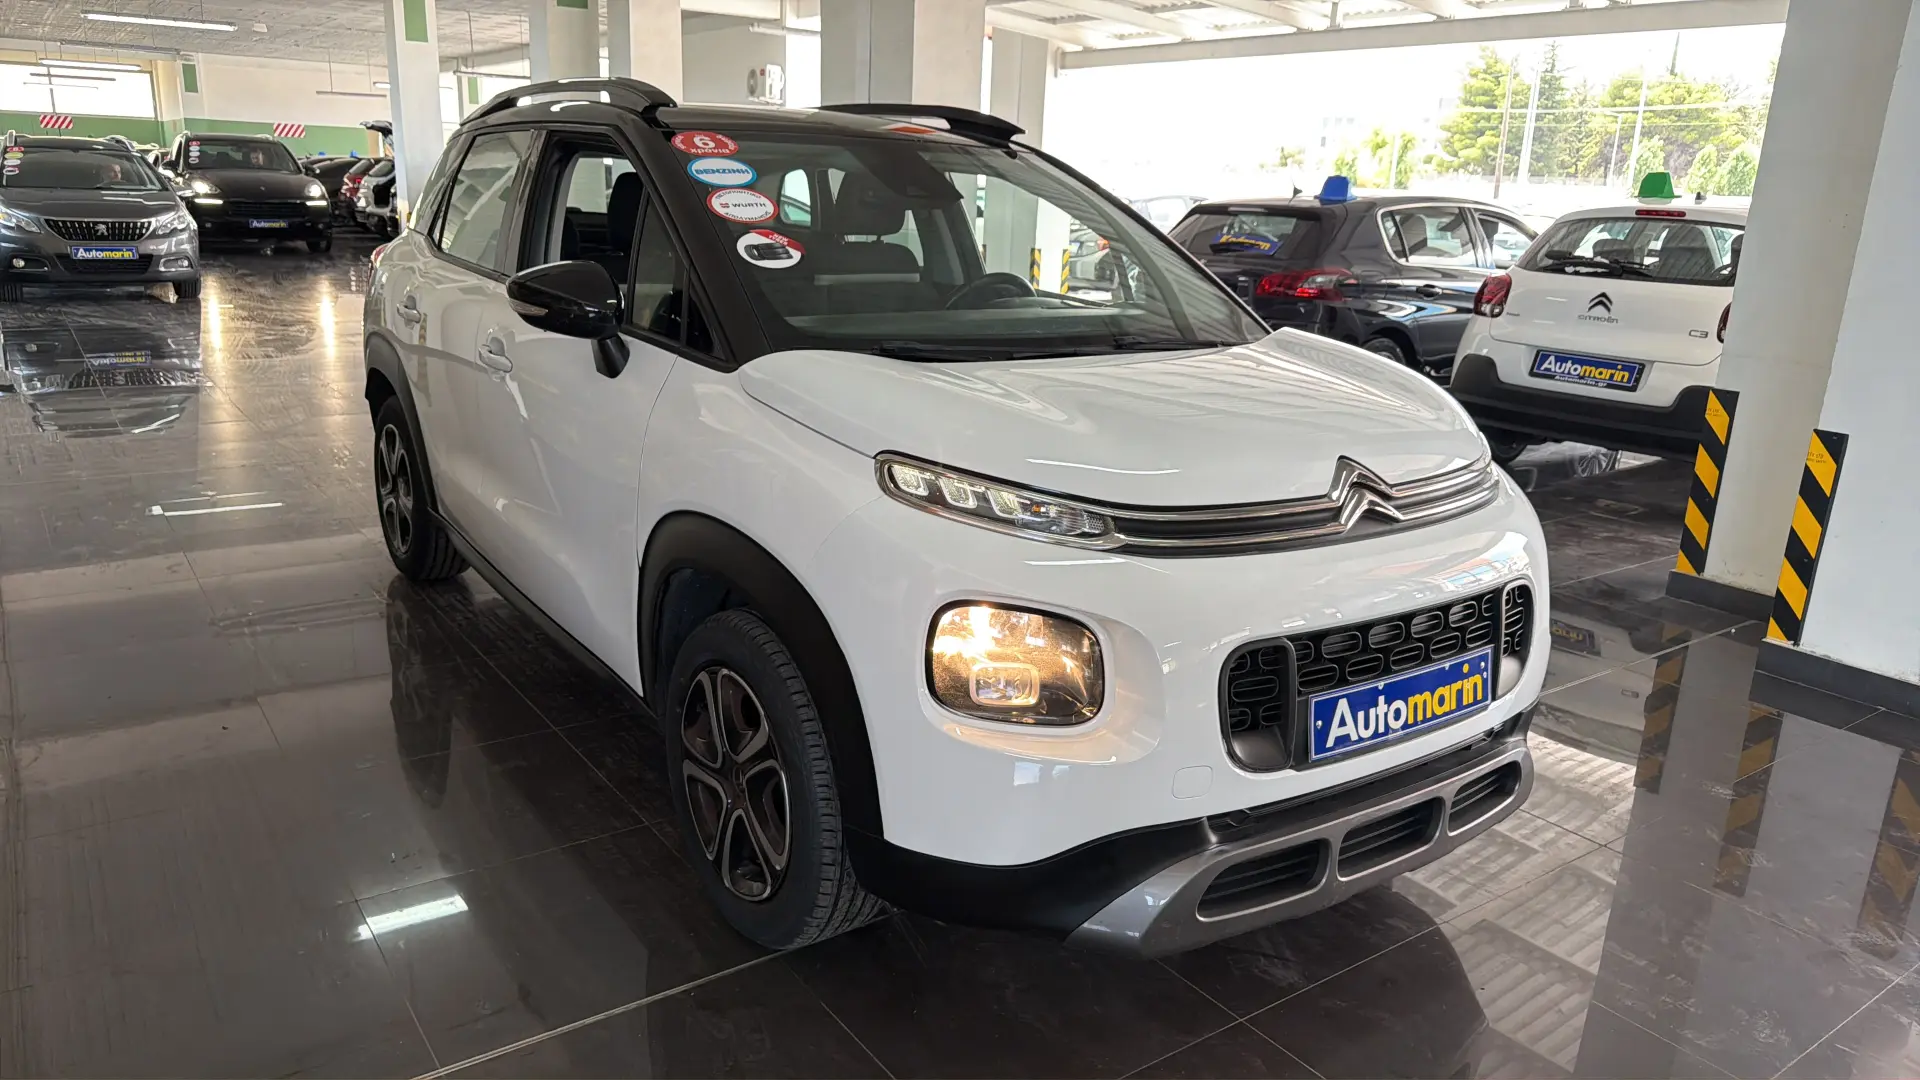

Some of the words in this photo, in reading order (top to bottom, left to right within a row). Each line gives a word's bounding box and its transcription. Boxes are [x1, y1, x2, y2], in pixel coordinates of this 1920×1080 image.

[693, 135, 716, 149] 6
[77, 247, 133, 258] Automarin
[1688, 329, 1709, 339] C3
[1540, 355, 1629, 383] Automarin
[1325, 663, 1483, 748] Automarin
